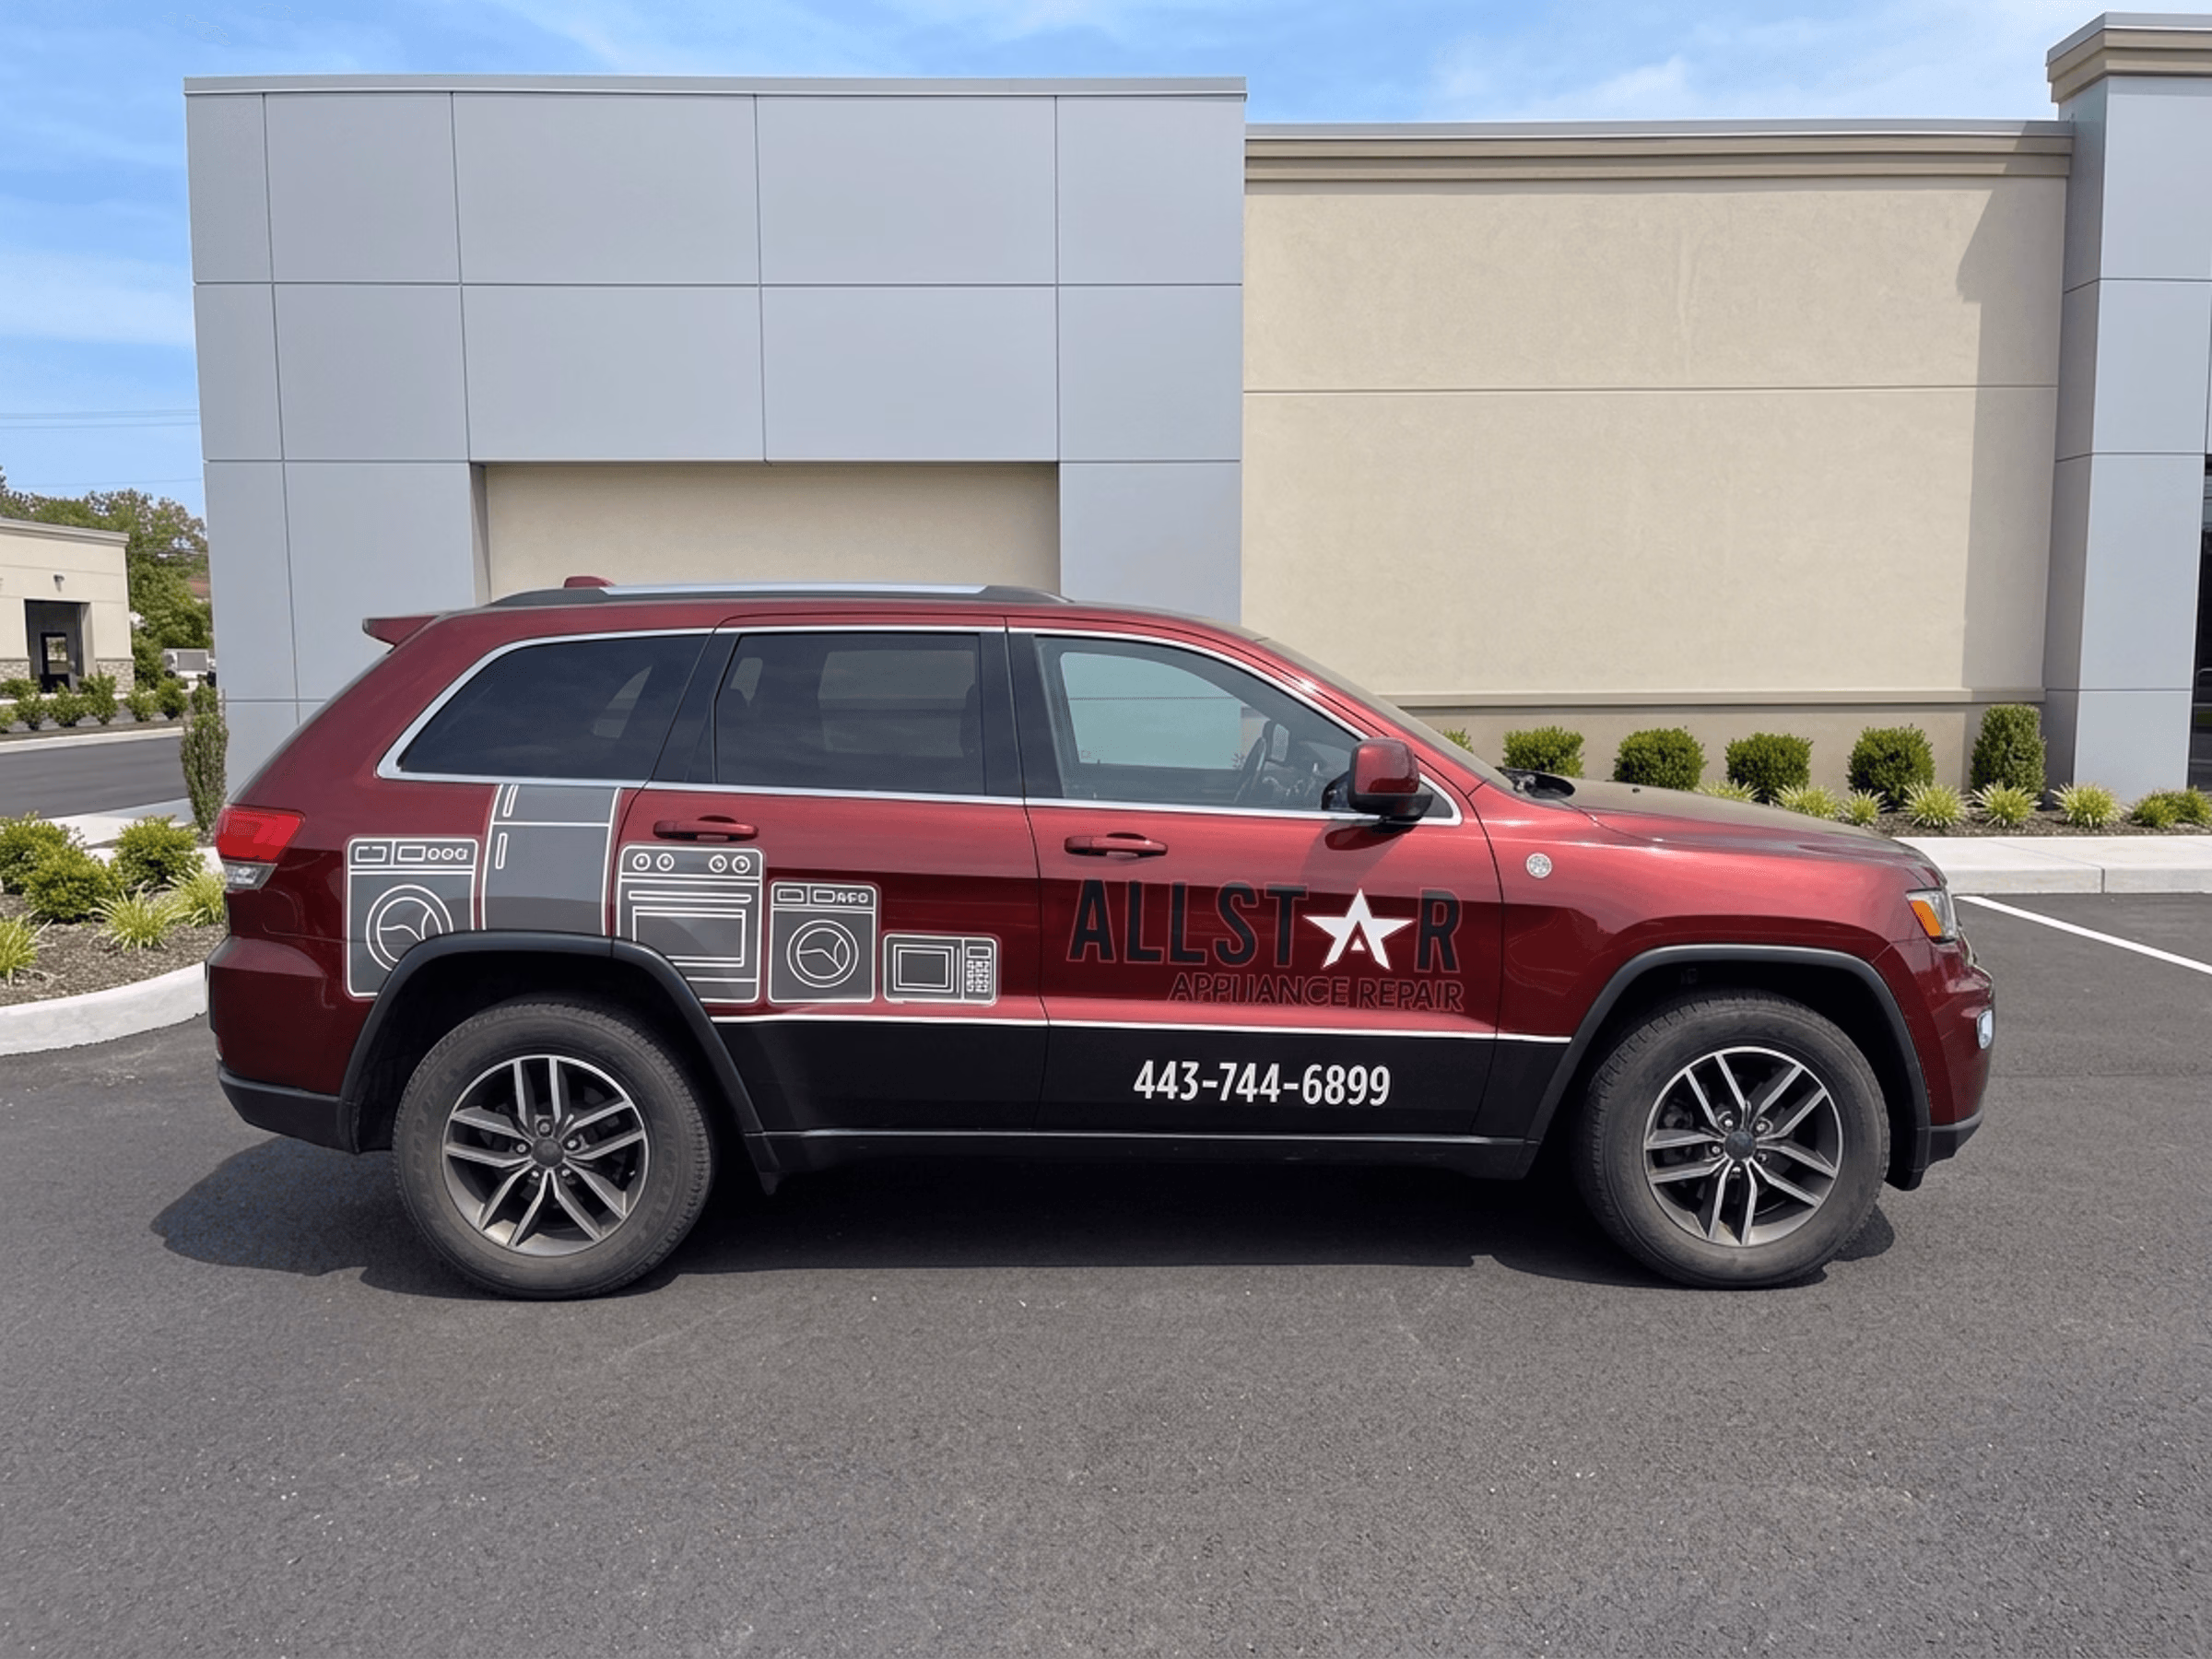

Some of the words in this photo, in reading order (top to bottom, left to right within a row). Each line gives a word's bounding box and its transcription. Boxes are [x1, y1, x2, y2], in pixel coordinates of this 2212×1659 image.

[1066, 878, 1463, 973] ALLSTAR
[1357, 977, 1465, 1012] REPAIR
[1133, 1060, 1391, 1106] 443-744-6899
